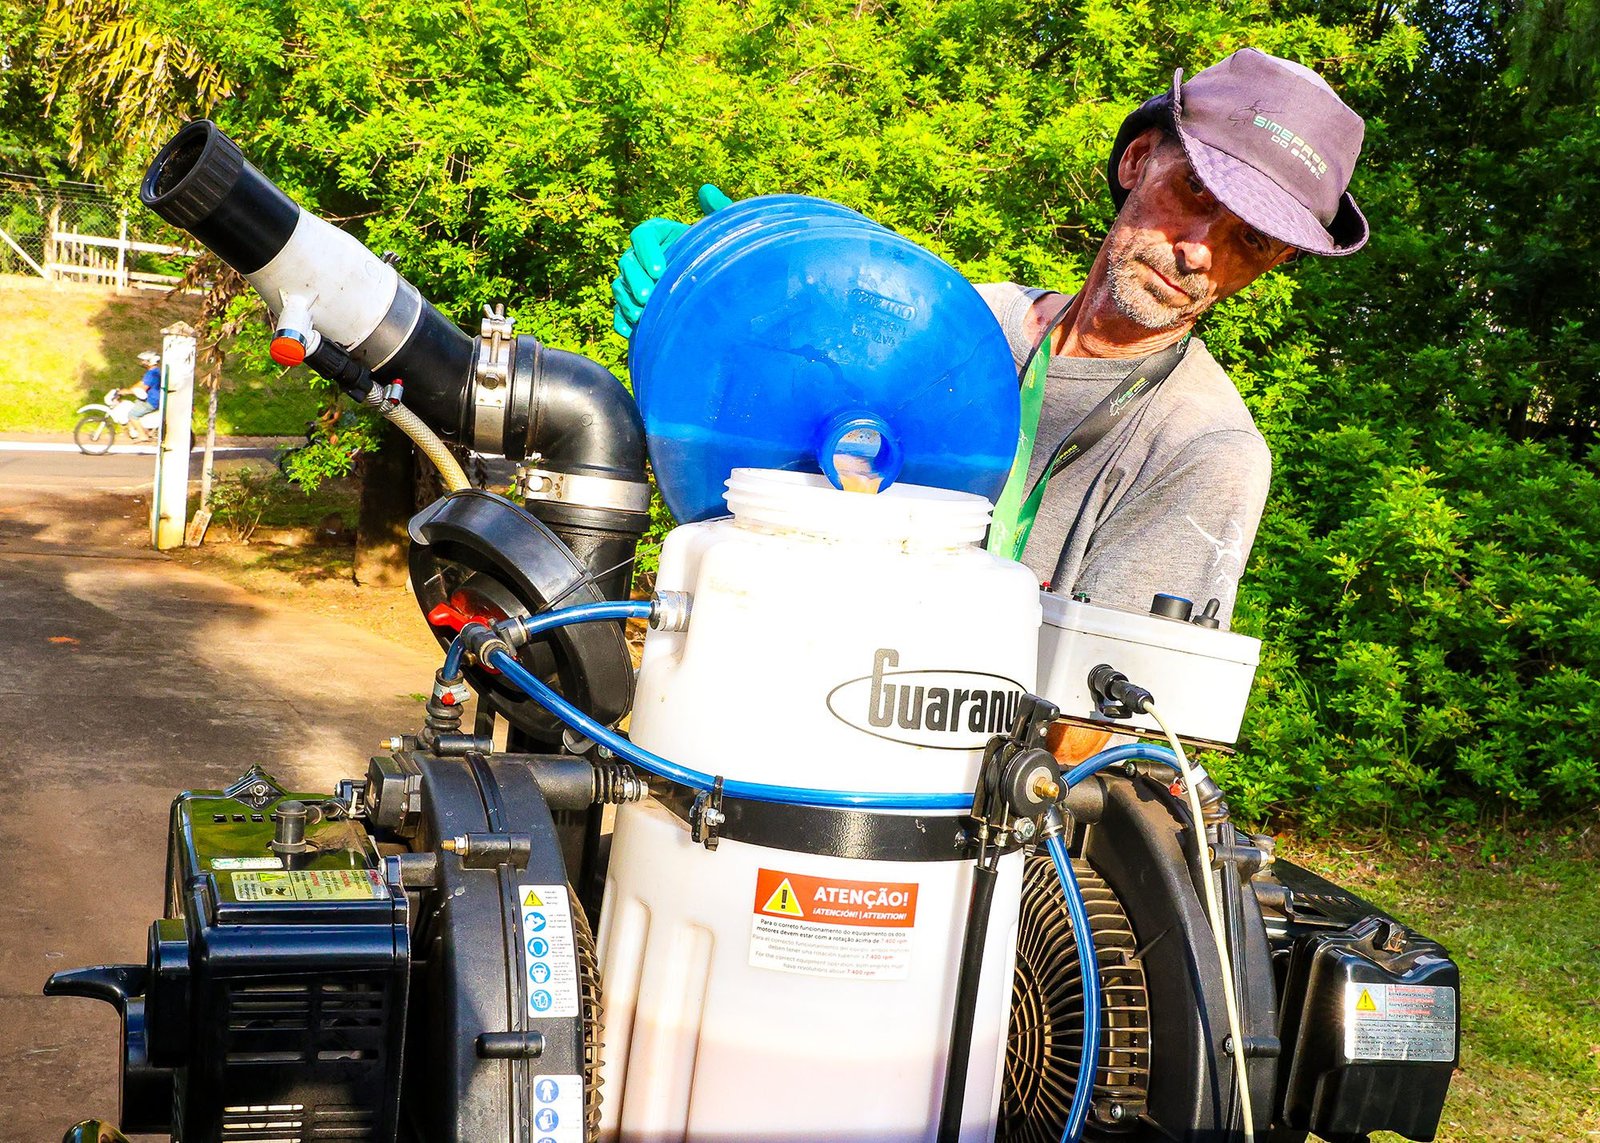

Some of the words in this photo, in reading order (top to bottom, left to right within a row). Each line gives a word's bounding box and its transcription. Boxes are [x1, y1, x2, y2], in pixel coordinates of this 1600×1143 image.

[813, 886, 909, 909] ATENÇÃO!
[862, 911, 907, 920] ATTENTION!
[756, 926, 779, 934] motores
[780, 929, 799, 937] devem
[760, 918, 772, 926] Para
[778, 922, 799, 930] correto
[799, 925, 842, 934] funcionamento
